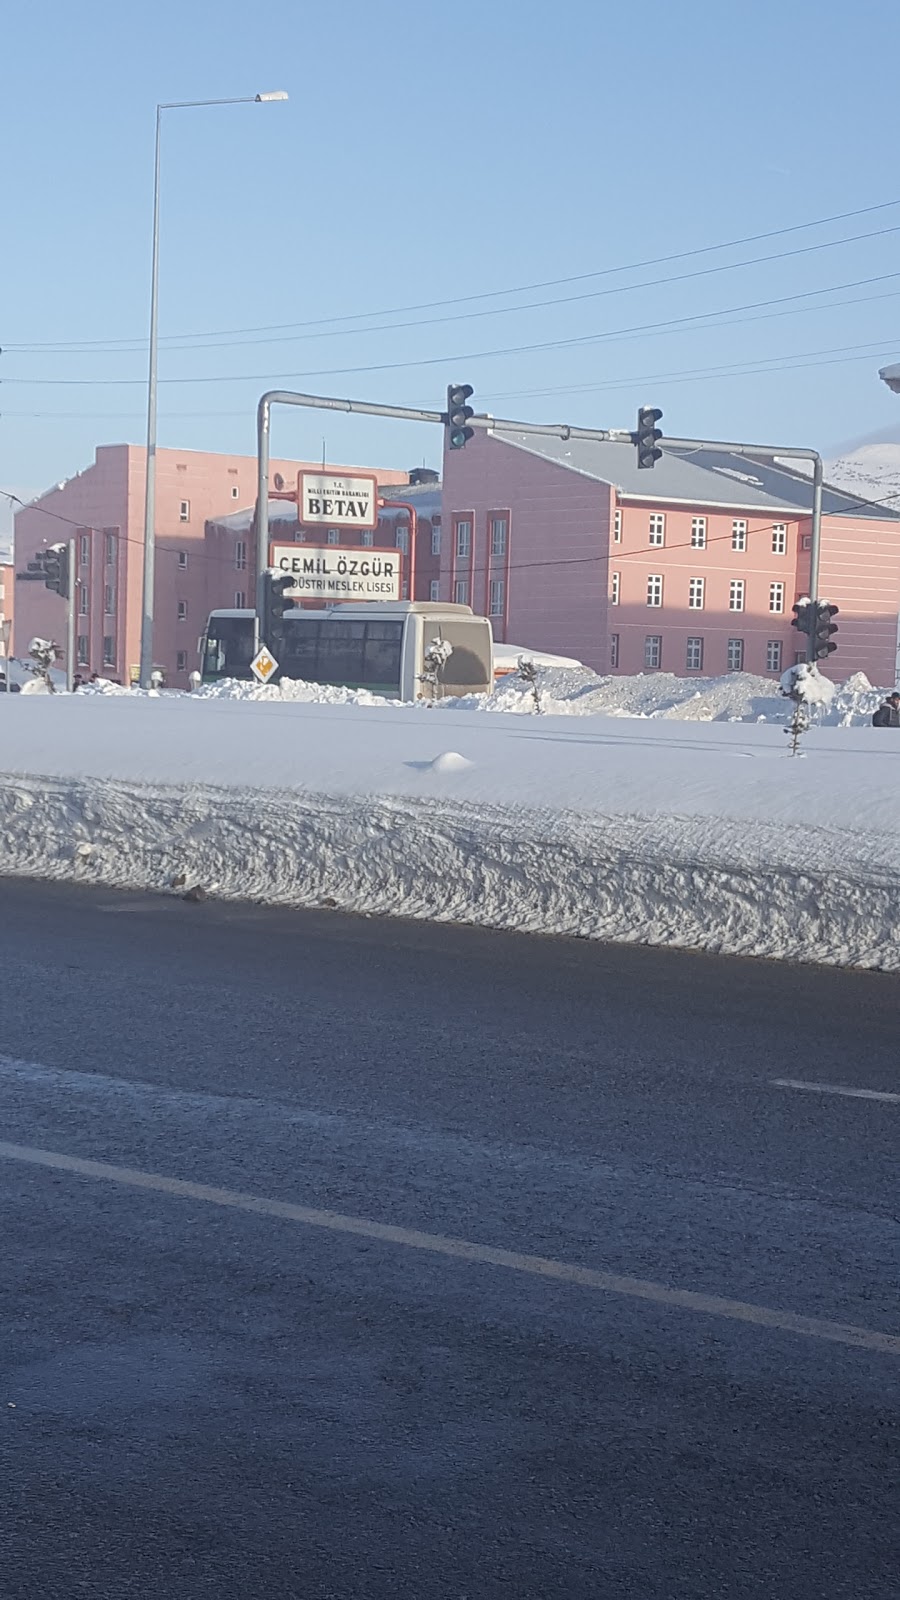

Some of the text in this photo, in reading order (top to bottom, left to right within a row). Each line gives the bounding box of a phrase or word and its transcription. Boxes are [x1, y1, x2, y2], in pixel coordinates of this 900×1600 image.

[308, 498, 369, 518] BETAV
[337, 556, 393, 578] ÖZGÜR
[328, 579, 365, 592] MESLEK
